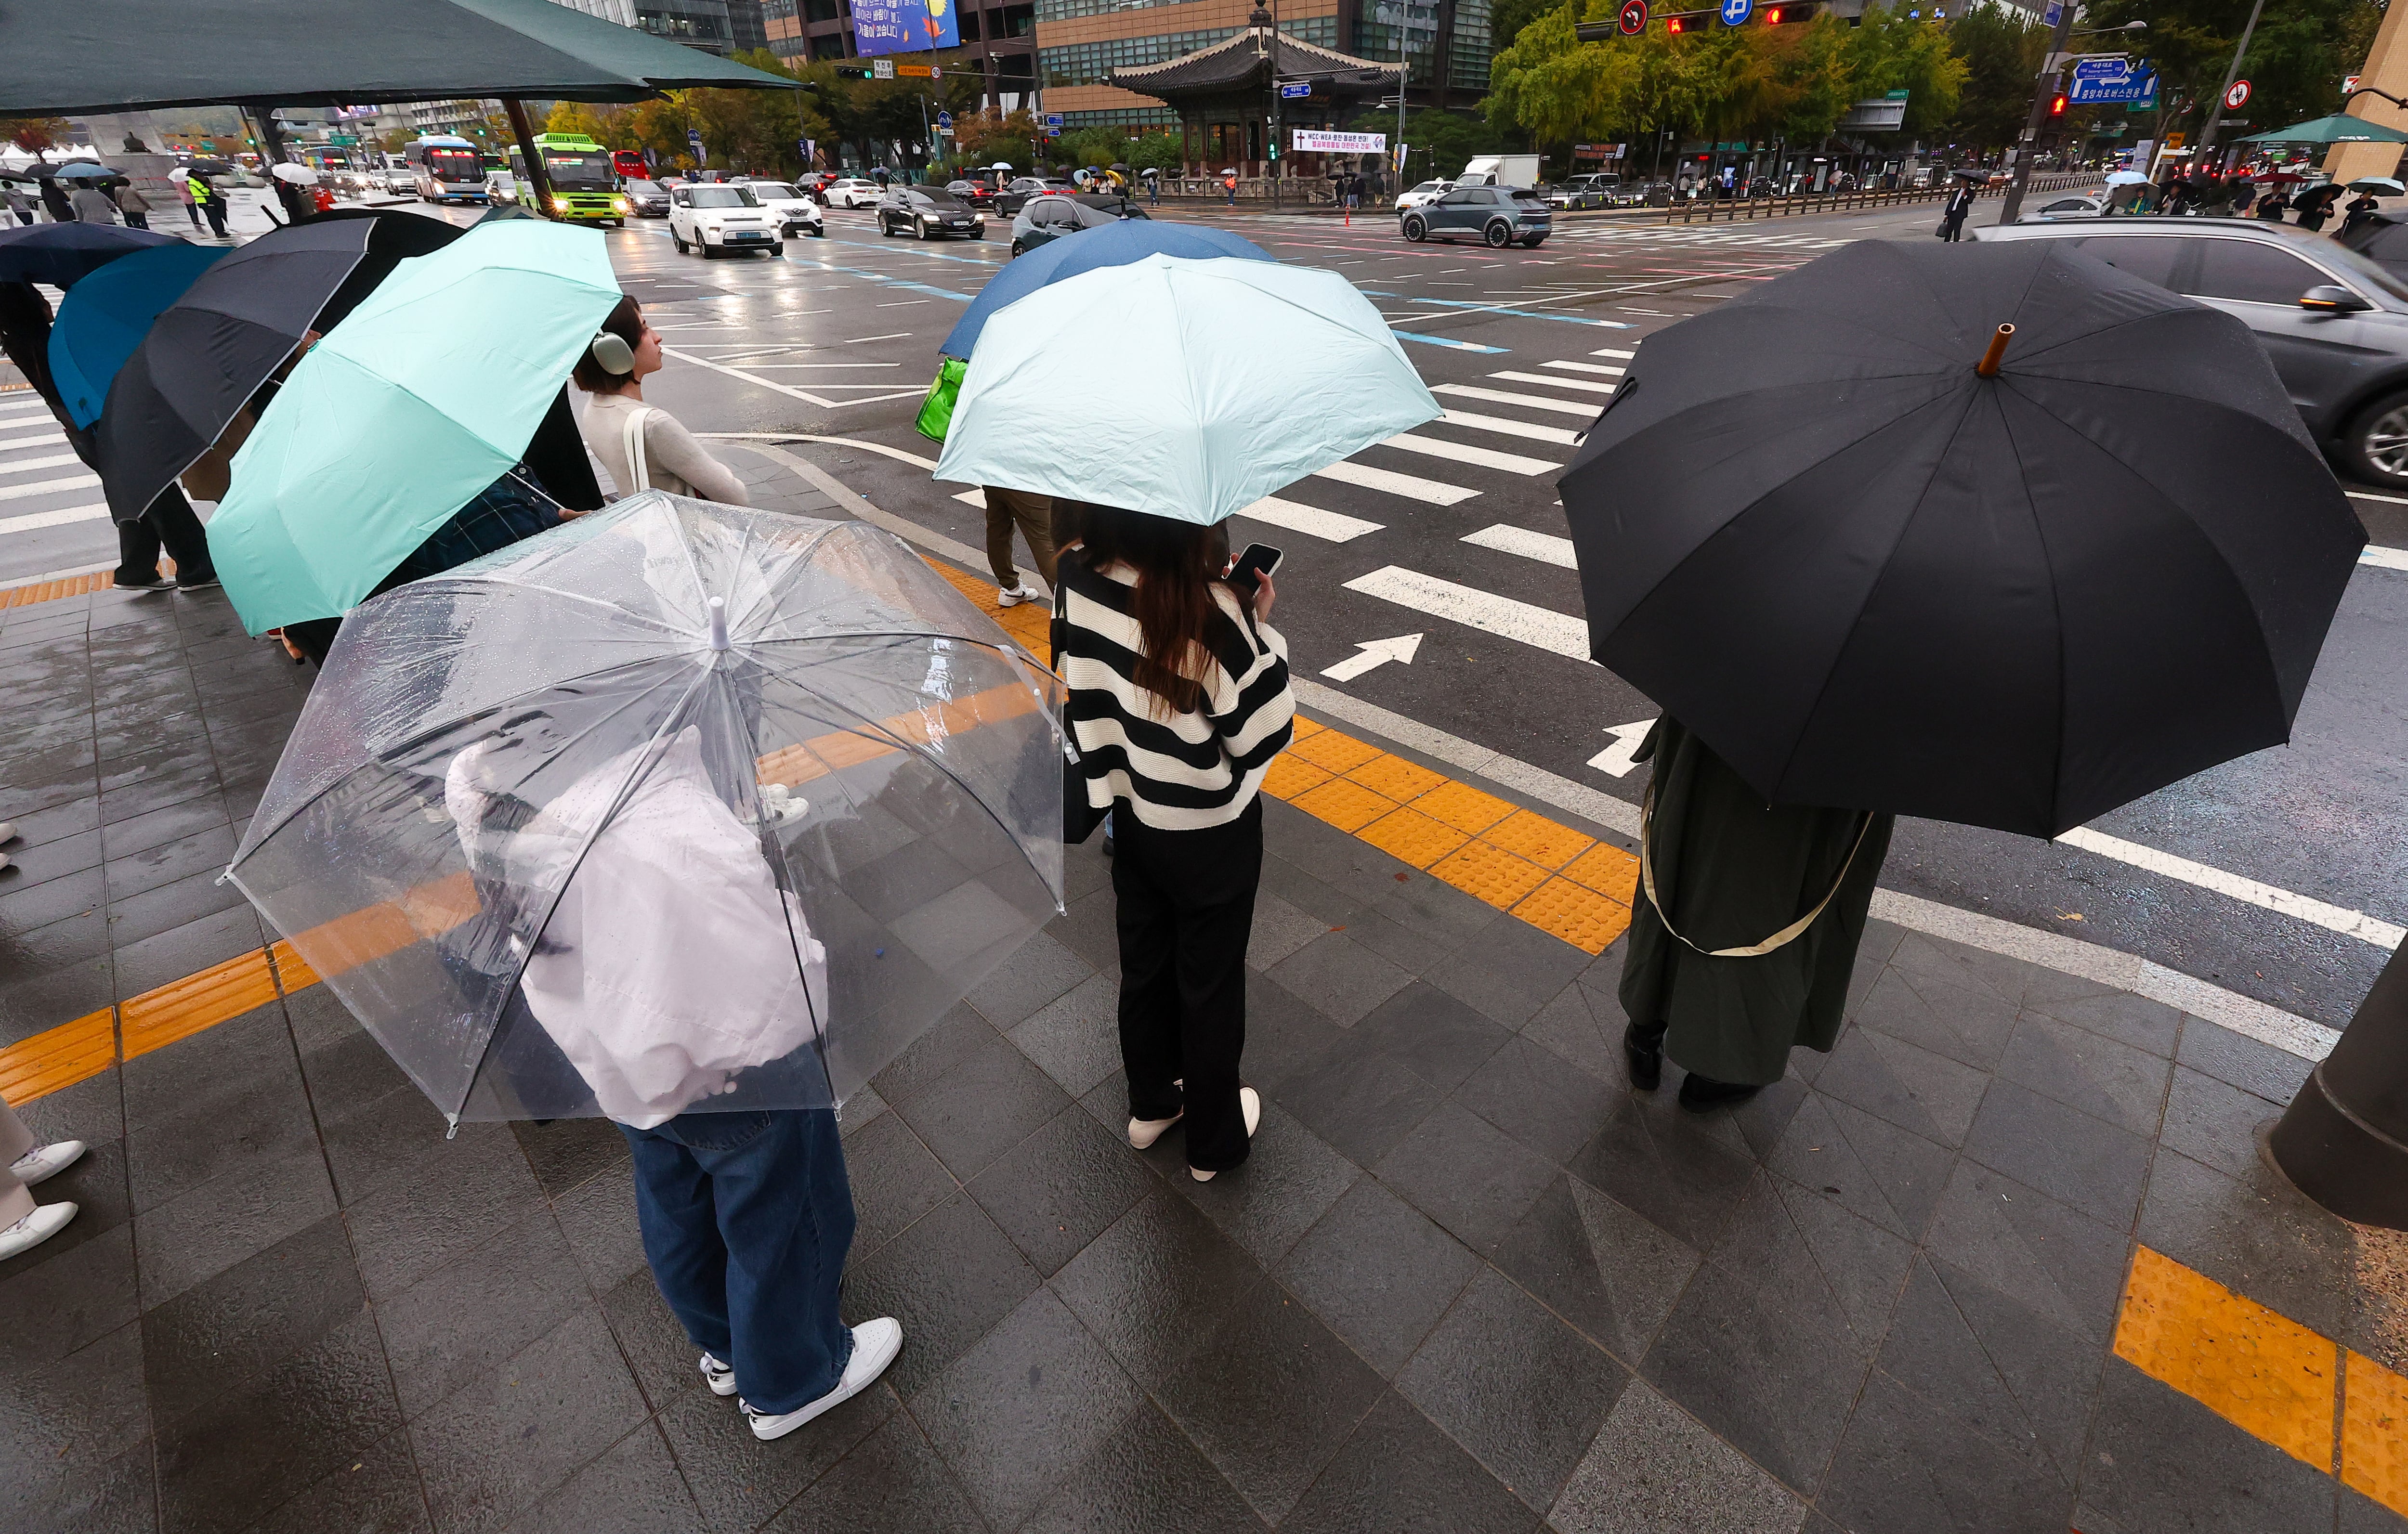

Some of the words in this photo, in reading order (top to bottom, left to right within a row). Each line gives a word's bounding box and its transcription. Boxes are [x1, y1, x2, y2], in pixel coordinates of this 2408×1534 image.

[873, 9, 889, 21] 바람이
[858, 23, 874, 38] 가을이
[877, 24, 897, 39] 있습니다
